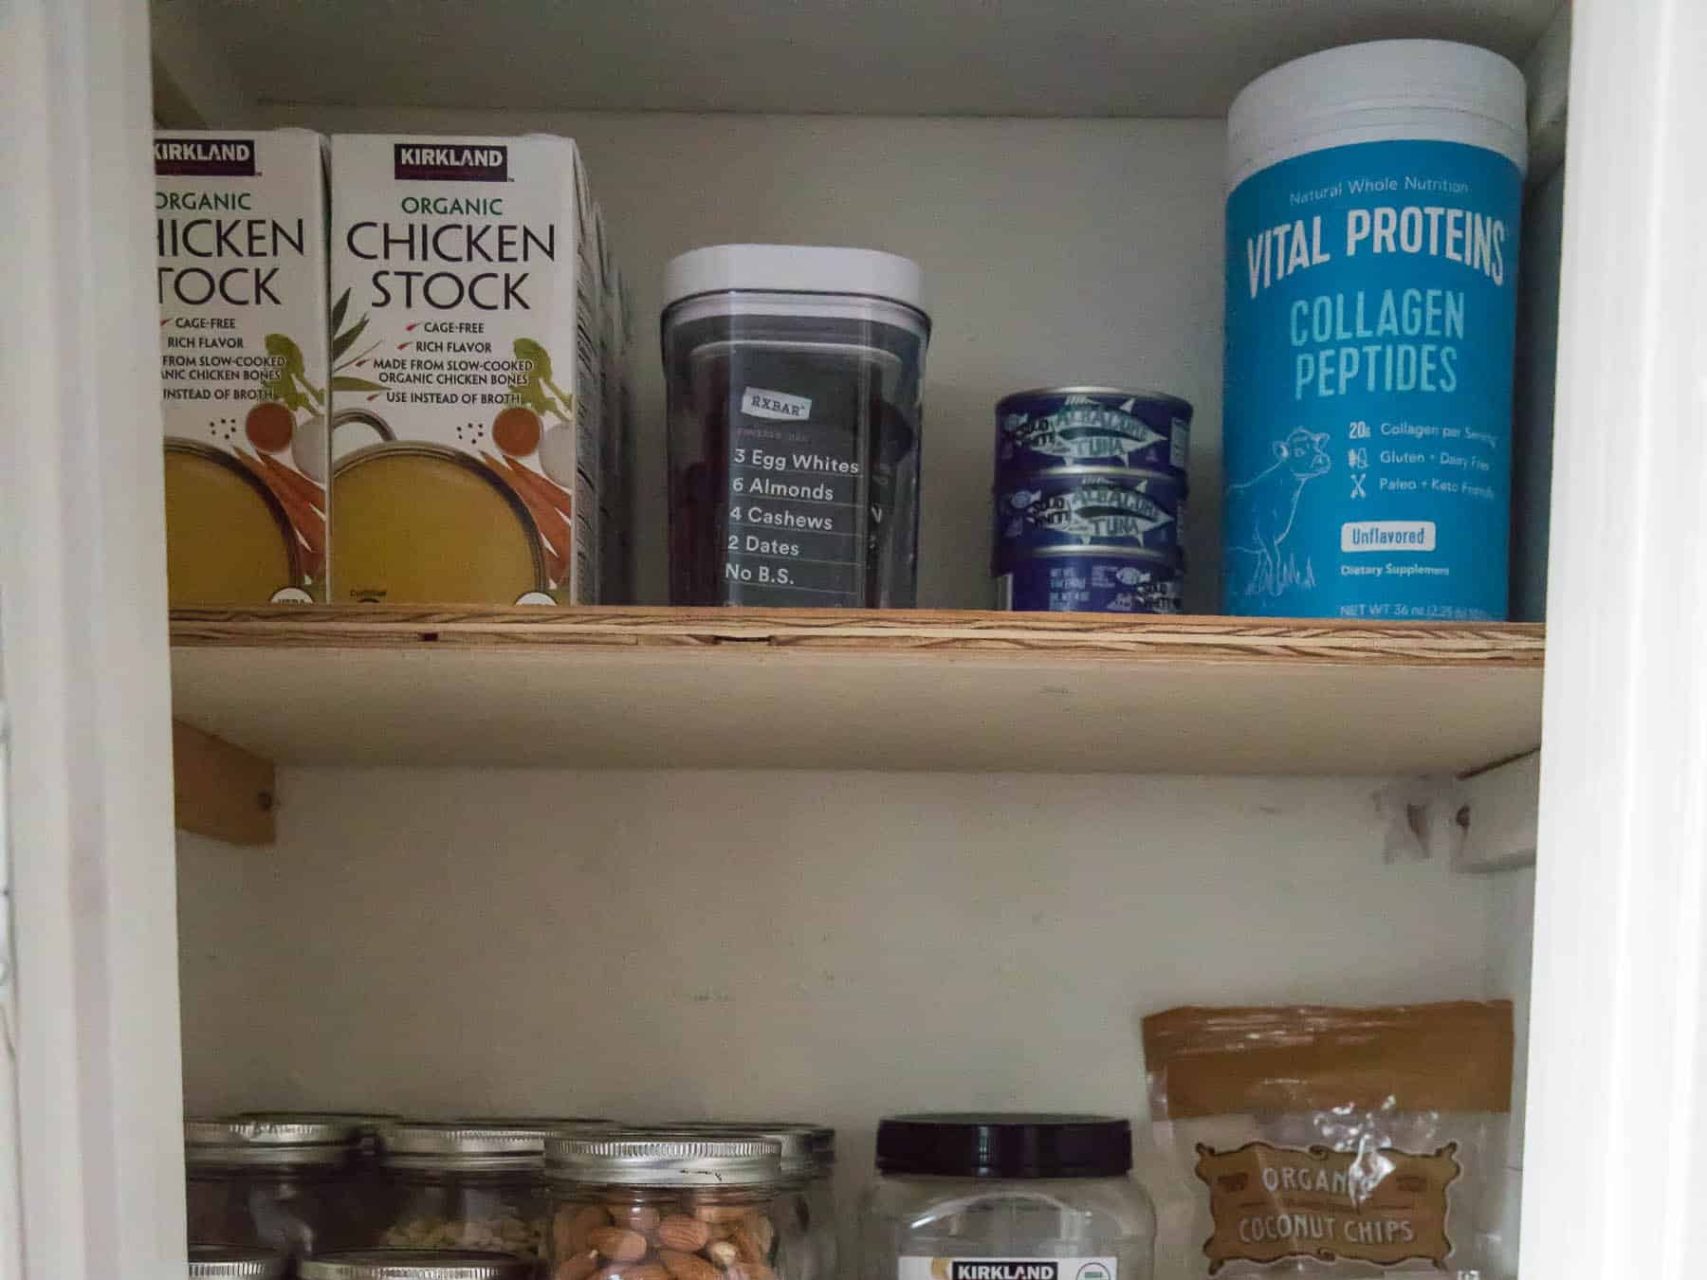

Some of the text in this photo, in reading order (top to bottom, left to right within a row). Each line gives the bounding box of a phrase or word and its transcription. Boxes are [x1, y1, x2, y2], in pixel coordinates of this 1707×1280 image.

[401, 148, 503, 167] KIRKLAND
[1289, 175, 1469, 205] Natural Whole Nutrition
[401, 196, 503, 215] ORGANIC
[346, 221, 555, 262] CHICKEN
[1247, 206, 1505, 299] VITAL PROTEINS
[371, 270, 531, 310] STOCK
[175, 318, 236, 329] CAGE-FREE
[1290, 288, 1465, 347] COLLAGEN
[423, 322, 485, 333] CAGE-FREE
[167, 337, 244, 348] RICH FLAVOR
[415, 341, 492, 353] RICH FLAVOR
[162, 355, 287, 367] FROM SLOW-COOKED
[373, 359, 533, 371] MADE FROM SLOW-COOKED
[188, 369, 240, 380] CHICKEN
[243, 370, 281, 381] BONES
[378, 372, 528, 385] ORGANIC CHICKEN BONES
[1295, 344, 1457, 400] PEPTIDES
[162, 389, 274, 400] INSTEAD OF BROTH
[386, 392, 521, 405] USE INSTEAD OF BROTH
[751, 395, 801, 416] RXBAR
[734, 448, 860, 474] 3 Egg Whites
[1379, 450, 1425, 464] Gluten
[732, 477, 834, 501] 6 Almonds
[730, 506, 833, 531] 4 Cashews
[1093, 517, 1140, 537] TUNA
[727, 535, 800, 556] 2 Dates
[1352, 528, 1425, 545] Unflavored
[725, 563, 795, 585] No B.S.
[1262, 1167, 1368, 1194] ORGAN
[1239, 1214, 1414, 1243] COCONUT CHIPS
[958, 1265, 1054, 1280] KIRKLAND
